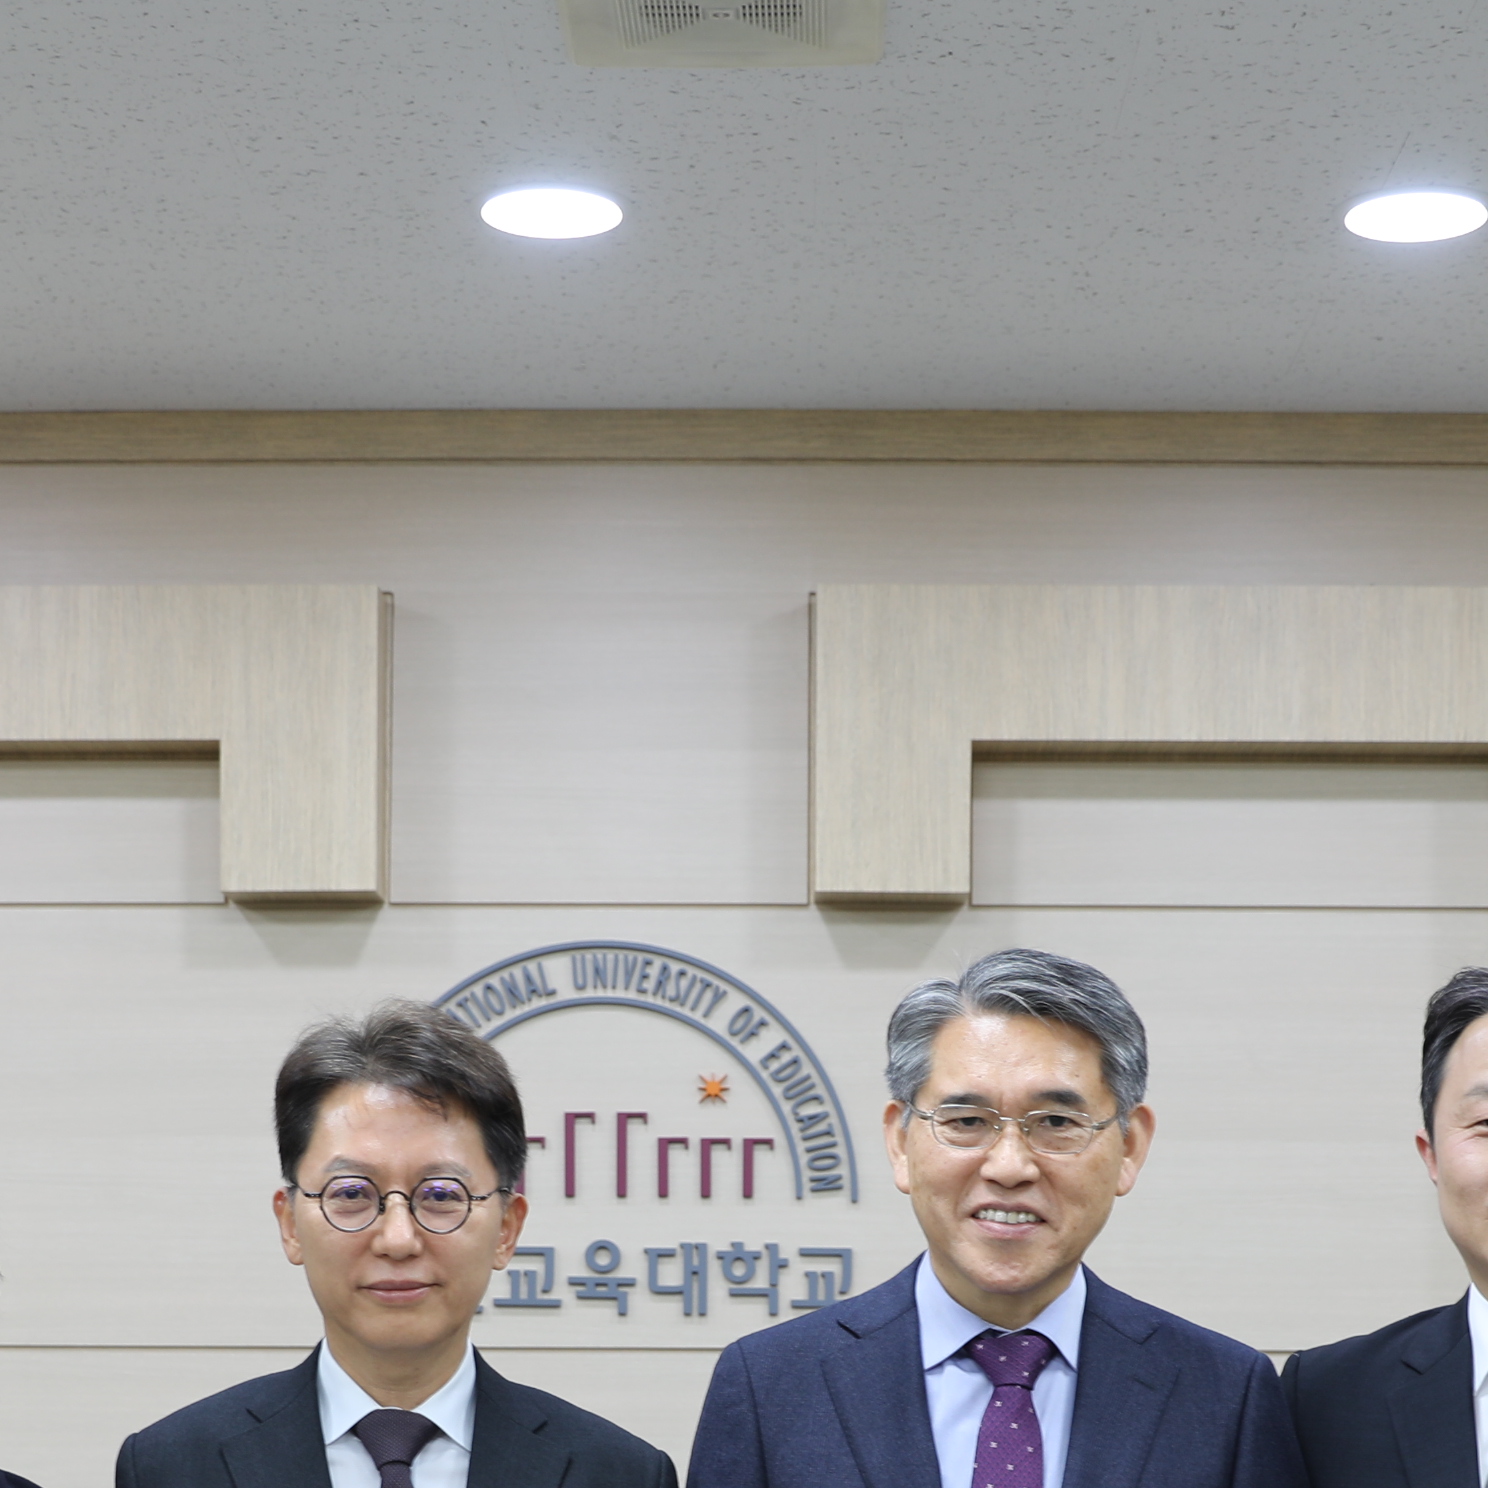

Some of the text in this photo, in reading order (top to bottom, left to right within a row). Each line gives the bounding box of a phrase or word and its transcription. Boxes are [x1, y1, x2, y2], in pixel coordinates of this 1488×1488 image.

[445, 952, 845, 1195] TIONAL UNIVERSITY OF EDUCATION
[476, 1239, 853, 1317] 교육대학교
